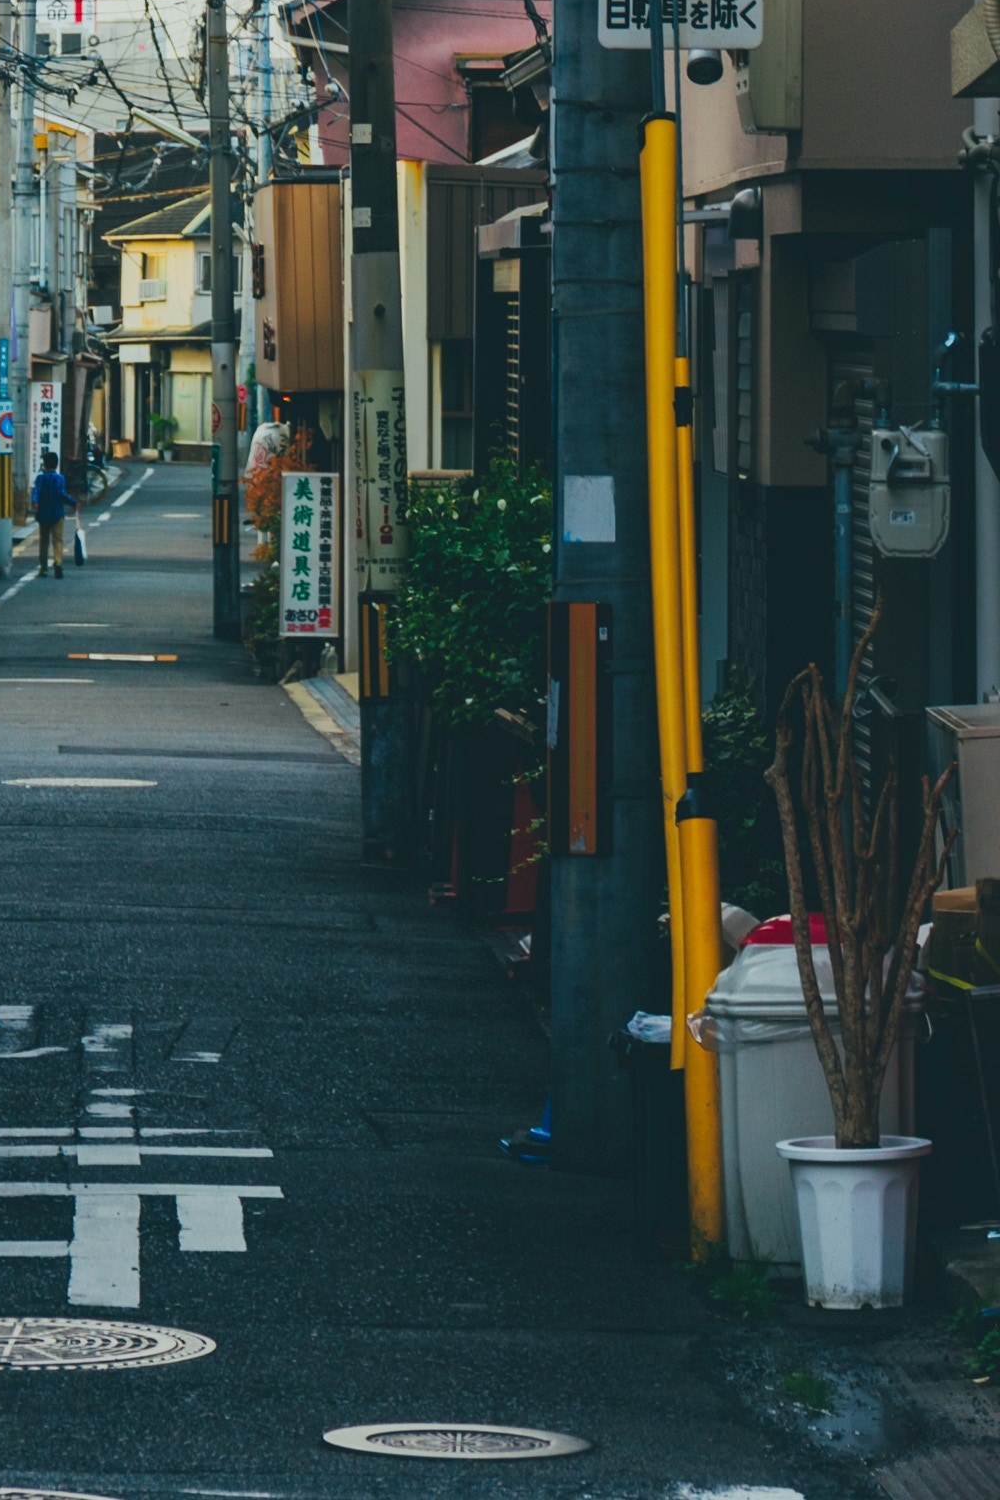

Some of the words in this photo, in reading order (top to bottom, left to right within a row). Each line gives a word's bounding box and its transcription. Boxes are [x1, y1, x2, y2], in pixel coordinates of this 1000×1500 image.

[291, 478, 314, 602] 美術道具店
[284, 608, 319, 623] あさひ
